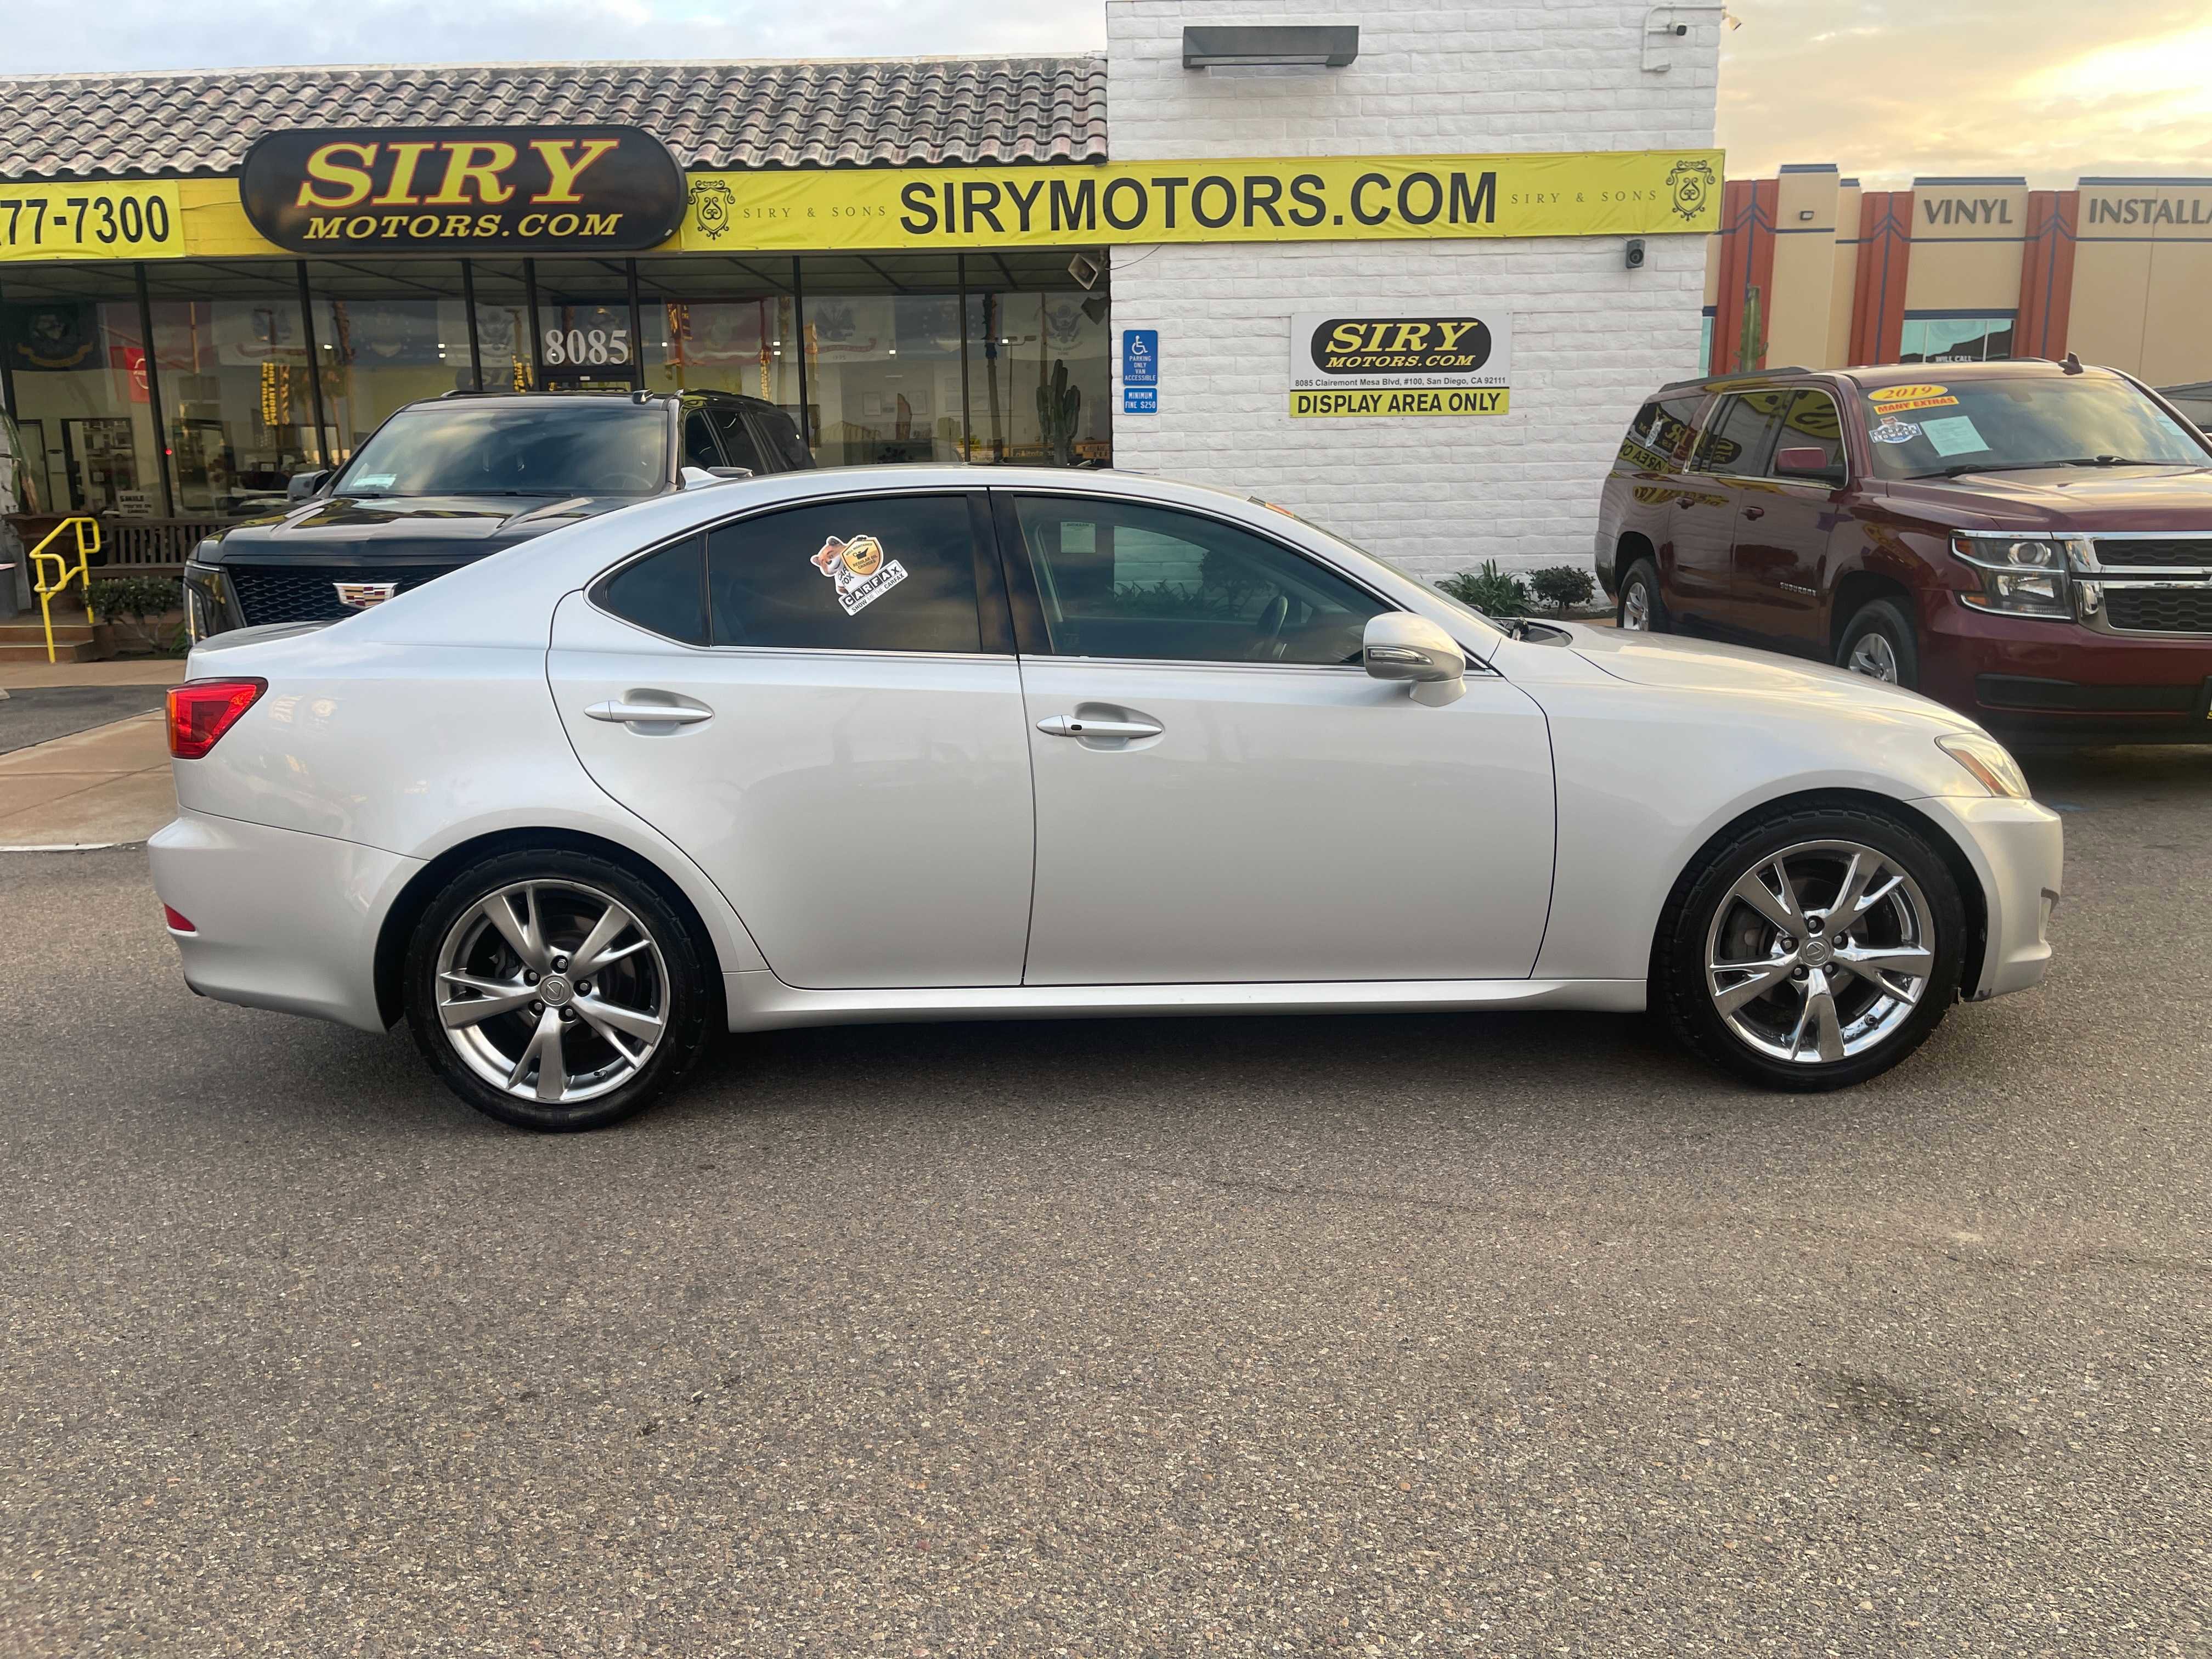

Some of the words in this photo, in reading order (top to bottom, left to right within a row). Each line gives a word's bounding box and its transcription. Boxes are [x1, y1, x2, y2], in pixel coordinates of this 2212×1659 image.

[295, 138, 620, 209] SIRY
[900, 172, 1497, 234] SIRYMOTORS.COM
[1511, 193, 1560, 204] SIRY
[1576, 194, 1585, 202] &
[1601, 190, 1657, 201] SONS
[0, 195, 169, 245] 77-7300
[744, 207, 791, 218] SIRY
[808, 208, 816, 217] &
[832, 206, 887, 217] SONS
[1924, 199, 2013, 224] VINYL
[2089, 198, 2212, 224] INSTALL
[303, 213, 623, 239] MOTORS.COM
[546, 330, 628, 364] 8085
[1325, 322, 1478, 353] SIRY
[1325, 355, 1476, 368] MOTORS.COM
[1444, 377, 1469, 386] Diego,
[1883, 386, 1932, 399] 2019
[1297, 394, 1383, 414] DISPLAY
[1387, 393, 1442, 413] AREA
[1448, 392, 1501, 411] ONLY
[1878, 402, 1911, 413] MANY
[1913, 397, 1954, 407] EXTRAS
[838, 565, 849, 580] CAR
[842, 573, 855, 585] FOX
[843, 566, 901, 607] CARFAX
[851, 599, 867, 613] SHOW
[884, 573, 905, 590] CARFAX
